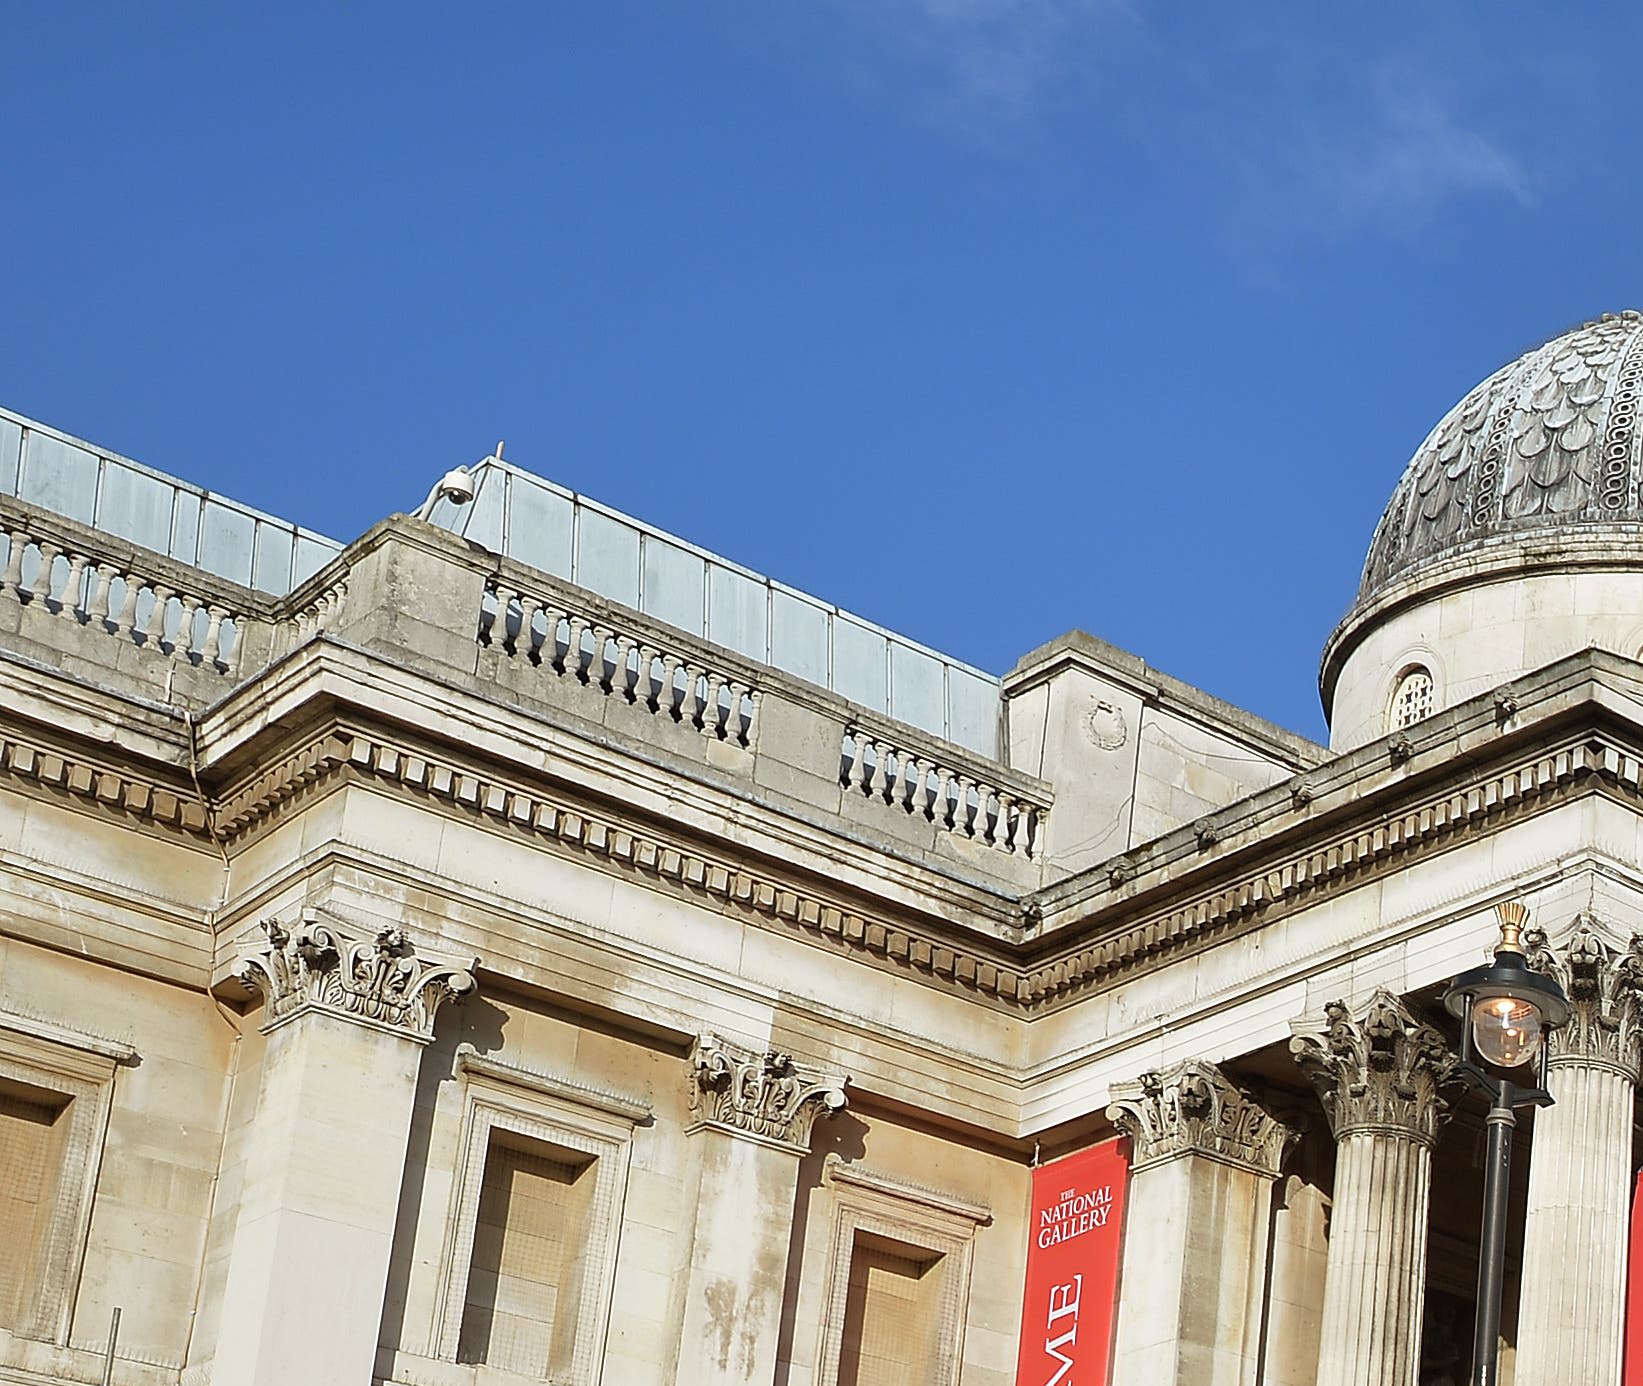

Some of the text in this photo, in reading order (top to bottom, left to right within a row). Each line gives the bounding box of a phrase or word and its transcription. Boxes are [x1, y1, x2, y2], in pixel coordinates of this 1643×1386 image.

[1040, 1185, 1113, 1228] NATIONAL
[1060, 1188, 1075, 1202] THE
[1038, 1203, 1112, 1249] GALLERY
